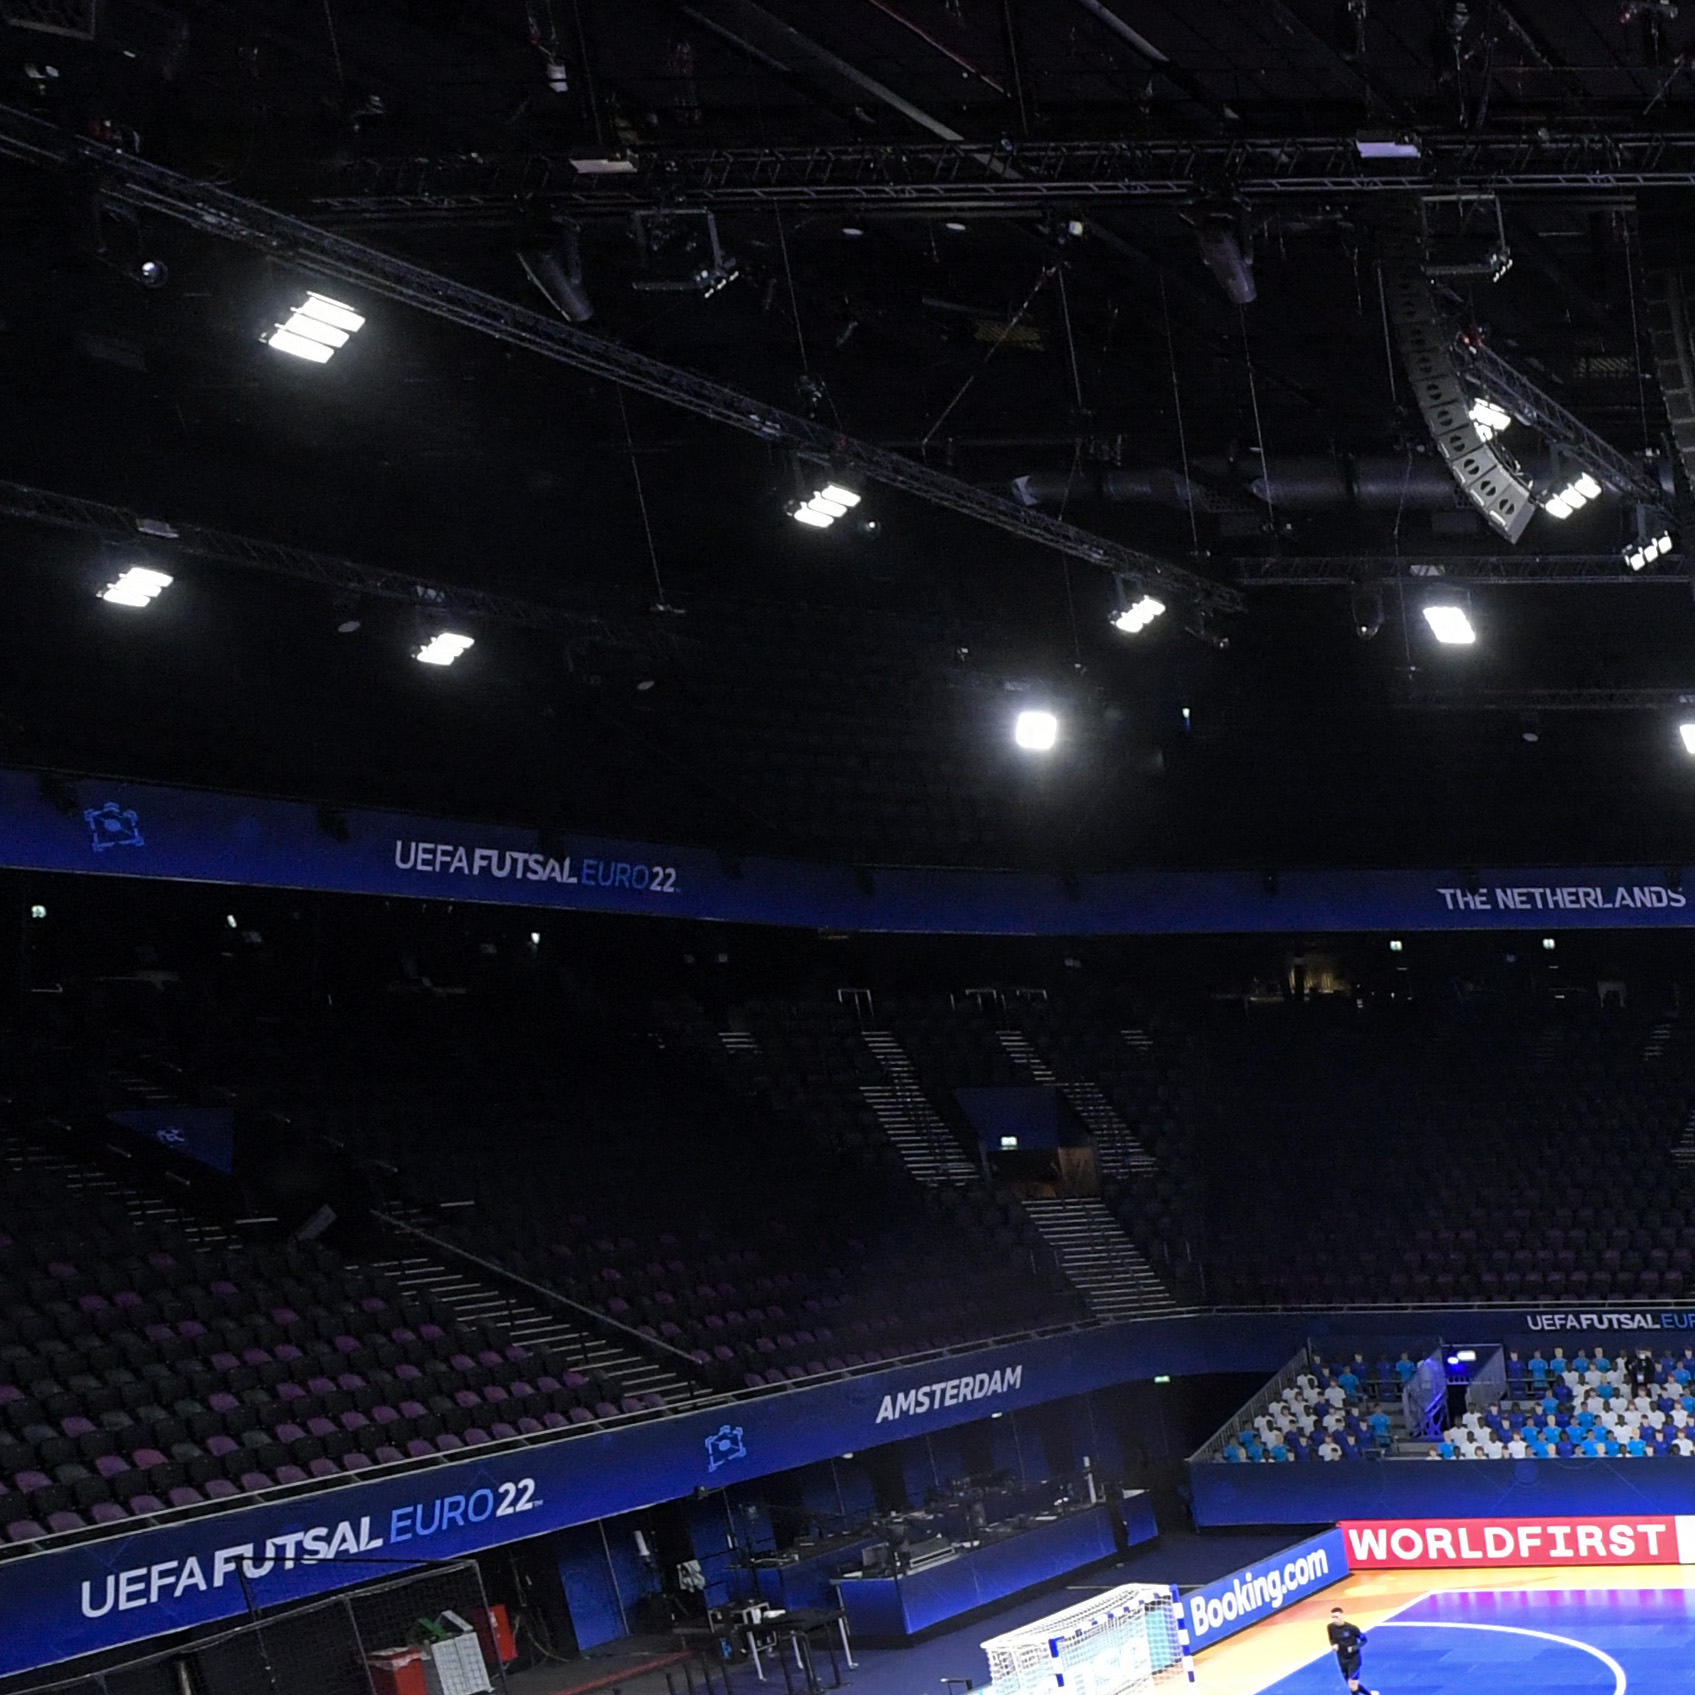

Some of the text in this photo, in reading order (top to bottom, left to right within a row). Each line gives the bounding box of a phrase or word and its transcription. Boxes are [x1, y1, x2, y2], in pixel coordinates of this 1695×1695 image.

[395, 840, 469, 875] UEFA
[472, 848, 578, 884] FUTSAL
[1438, 886, 1686, 910] THE NETHERLANDS
[1527, 1314, 1578, 1330] UEFA
[1580, 1314, 1660, 1330] FUTSAL
[876, 1365, 1022, 1424] AMSTERDAM
[1350, 1523, 1666, 1560] WORLDFIRST
[81, 1555, 208, 1618] UEFA
[212, 1516, 384, 1588] FUTSAL
[1191, 1546, 1329, 1637] Booking.com
